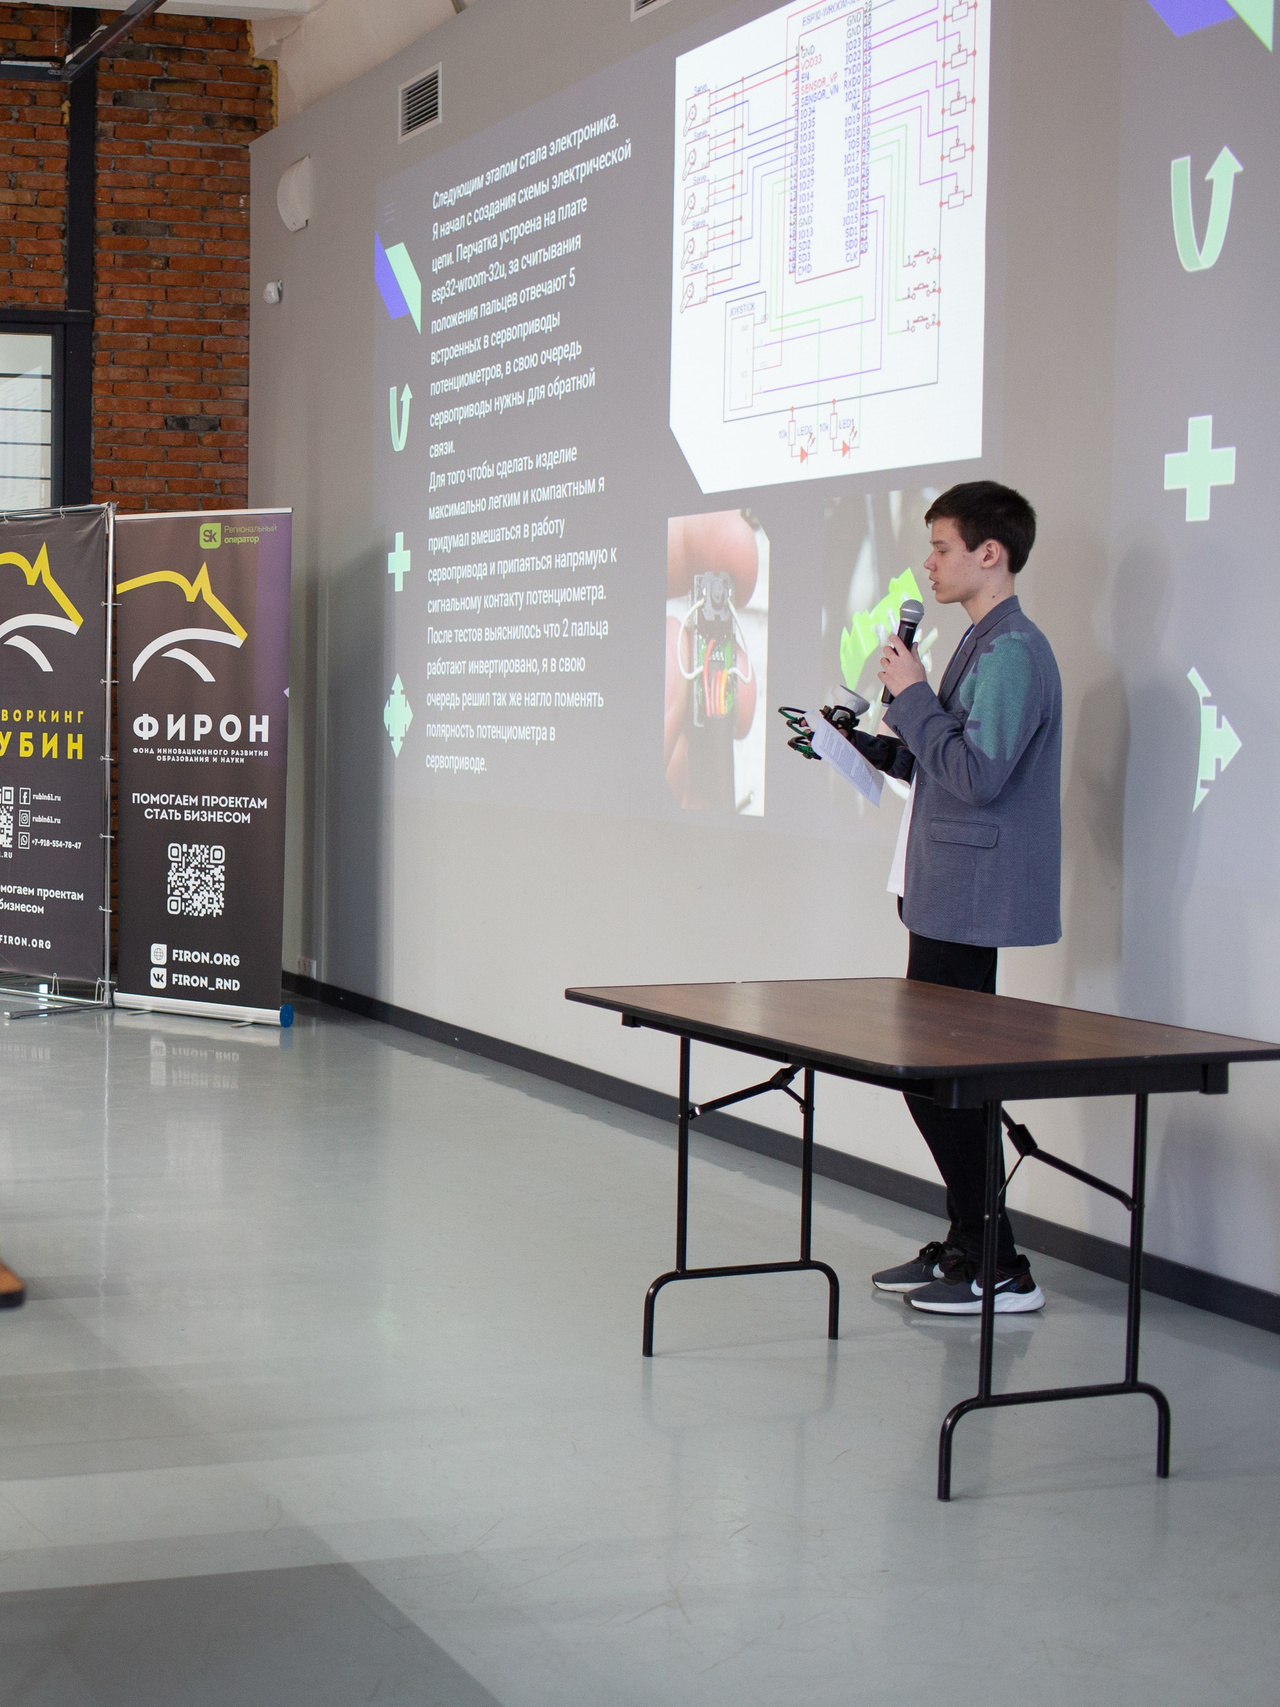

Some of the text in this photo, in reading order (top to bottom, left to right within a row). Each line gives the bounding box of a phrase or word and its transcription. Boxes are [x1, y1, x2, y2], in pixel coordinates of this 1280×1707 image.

[432, 113, 619, 210] Следующим этапом стала электроника.
[432, 137, 631, 241] Я начал с создания схемы электрической
[432, 197, 587, 274] цепи. Перчатка устроена на плате
[431, 233, 581, 304] esp32-wroom-32u, за считывания
[431, 266, 575, 335] положения пальцев отвечают 5
[729, 302, 755, 317] JOYSTICK
[431, 311, 560, 366] встроенных в сервоприводы
[430, 340, 582, 397] потенциометров, в свою очередь
[430, 366, 595, 430] сервоприводы нужны для обратной
[429, 440, 455, 458] связи.
[428, 446, 577, 493] Для того чтобы сделать изделие
[429, 476, 605, 520] максимально легким и компактным я
[203, 529, 217, 542] Sk
[224, 524, 277, 533] Региональный
[428, 515, 565, 556] придумал вмешаться в работу
[224, 536, 259, 544] оператор
[428, 547, 617, 586] сервопривода и припаяться напрямую к
[427, 585, 606, 614] сигнальному контакту потенциометра.
[427, 618, 608, 644] После тестов выяснилось что 2 пальца
[427, 656, 585, 679] работают инвертировано, я в свою
[427, 691, 604, 710] очередь решил так же нагло поменять
[133, 713, 269, 742] ФИРОН
[426, 723, 555, 744] полярность потенциометра в
[157, 748, 228, 756] ИННОВАЦИОННОГО
[426, 754, 486, 773] сервоприводе.
[32, 793, 61, 801] rubin61.ru
[132, 793, 268, 809] ПОМОГАЕМ ПРОЕКТАМ
[32, 816, 61, 824] rubin61.ru
[144, 808, 251, 824] СТАТЬ БИЗНЕСОМ
[32, 839, 82, 849] +7-918-554-78-47
[37, 887, 84, 901] проектам
[172, 949, 240, 966] FIRON.ORG
[172, 974, 240, 991] FIRON_RND
